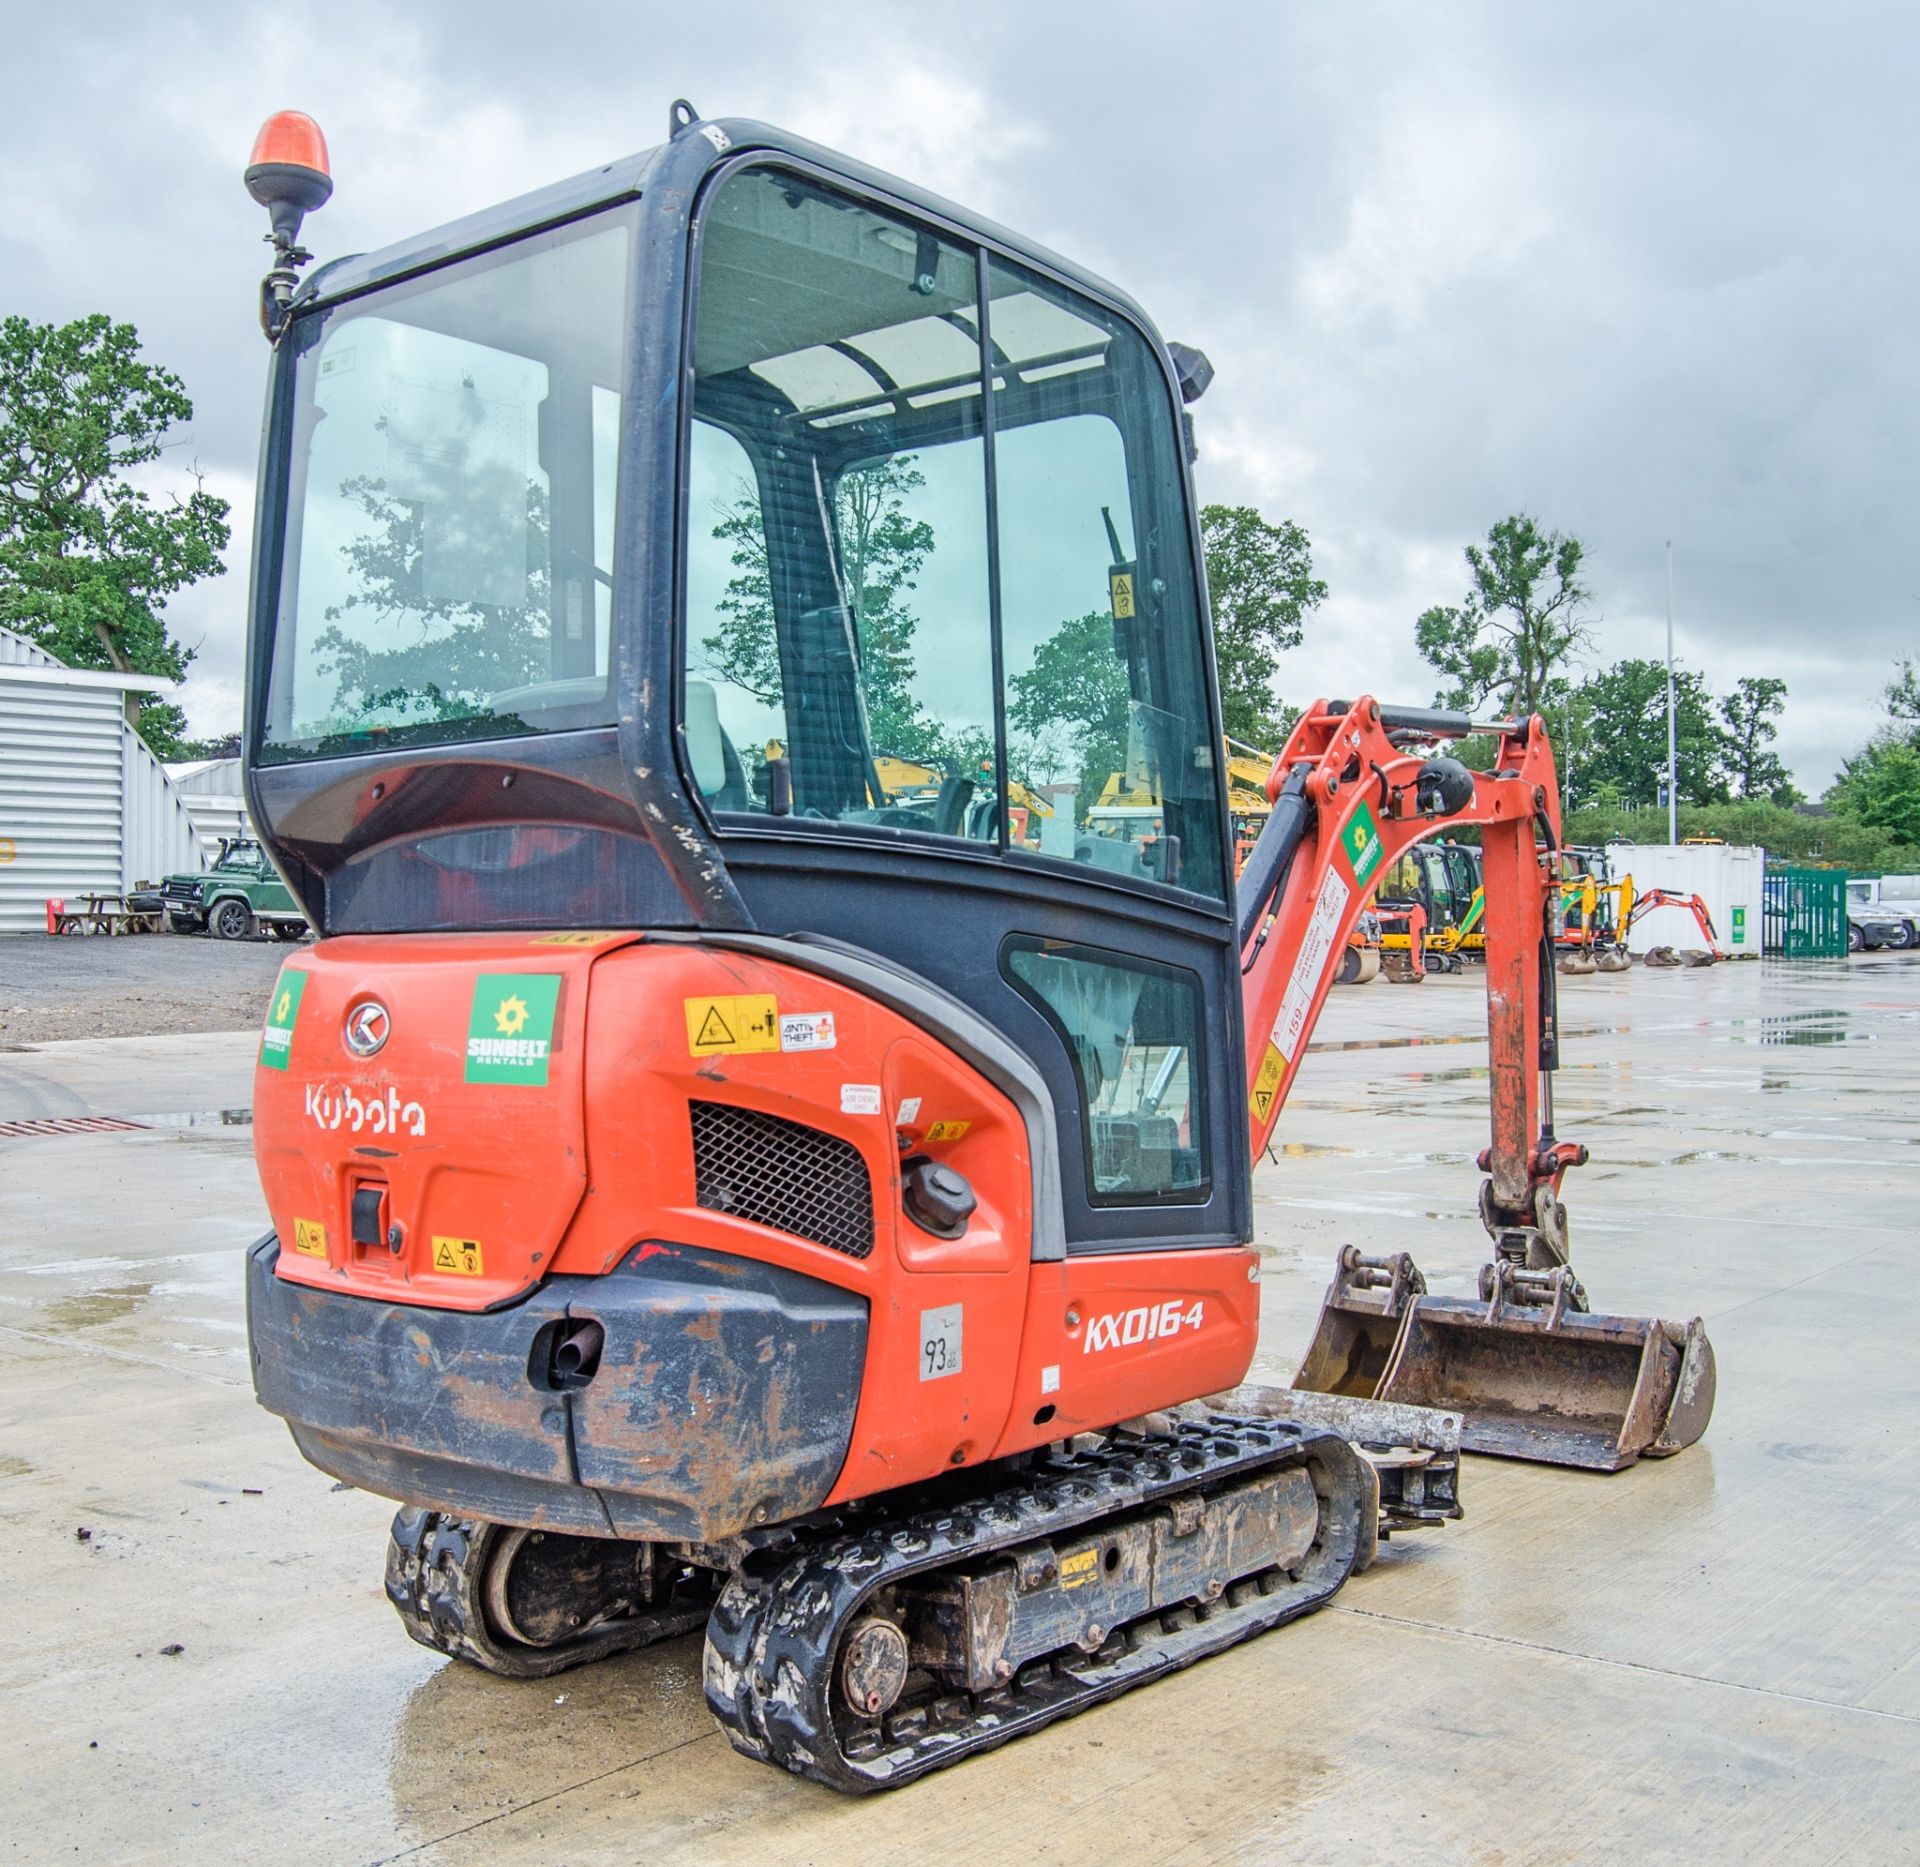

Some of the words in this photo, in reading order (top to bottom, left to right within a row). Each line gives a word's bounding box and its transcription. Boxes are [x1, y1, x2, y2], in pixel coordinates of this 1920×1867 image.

[1288, 1008, 1303, 1037] 159
[467, 1038, 548, 1058] SUNBELT
[784, 1032, 813, 1043] THEFT
[476, 1056, 534, 1066] RENTALS
[306, 1083, 426, 1136] Kubota
[925, 1337, 946, 1374] 93
